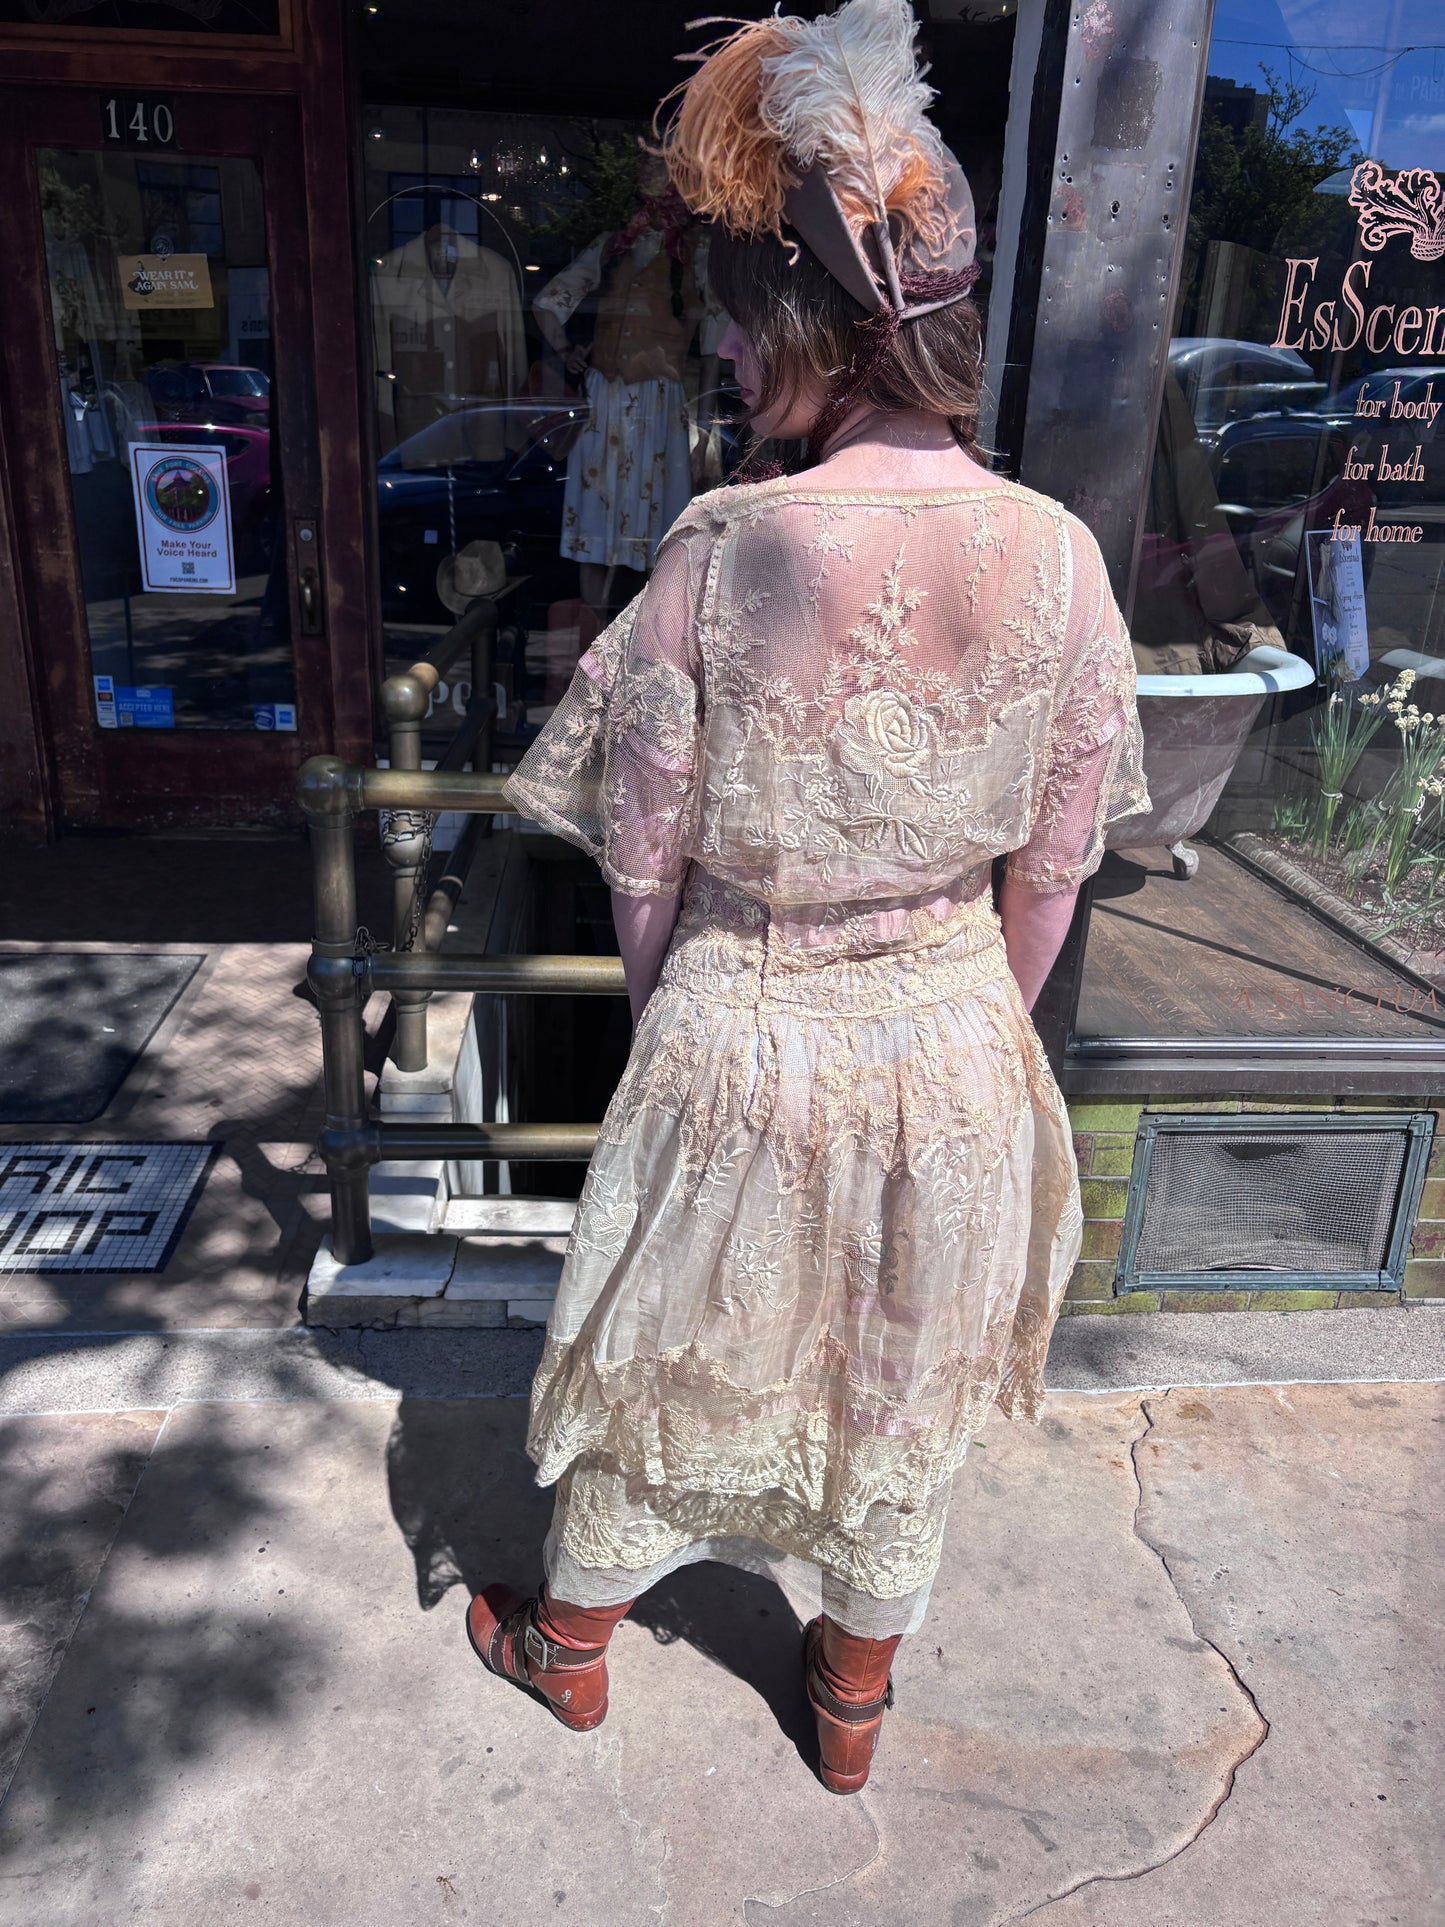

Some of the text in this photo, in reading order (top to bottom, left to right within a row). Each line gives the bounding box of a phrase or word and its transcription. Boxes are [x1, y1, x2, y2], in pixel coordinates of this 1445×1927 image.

[105, 99, 174, 143] 140
[132, 270, 186, 281] WEAR IT
[134, 280, 199, 291] AGAIN SAM
[1354, 381, 1442, 429] for body
[1342, 443, 1425, 482] for bath
[1330, 507, 1424, 543] for home
[156, 548, 218, 558] Voice Heard
[160, 539, 212, 550] Make Your
[118, 702, 153, 713] ACCEPTED
[153, 703, 171, 714] HERE
[424, 680, 507, 720] pen
[1232, 986, 1253, 1012] A
[0, 1155, 148, 1194] RIC
